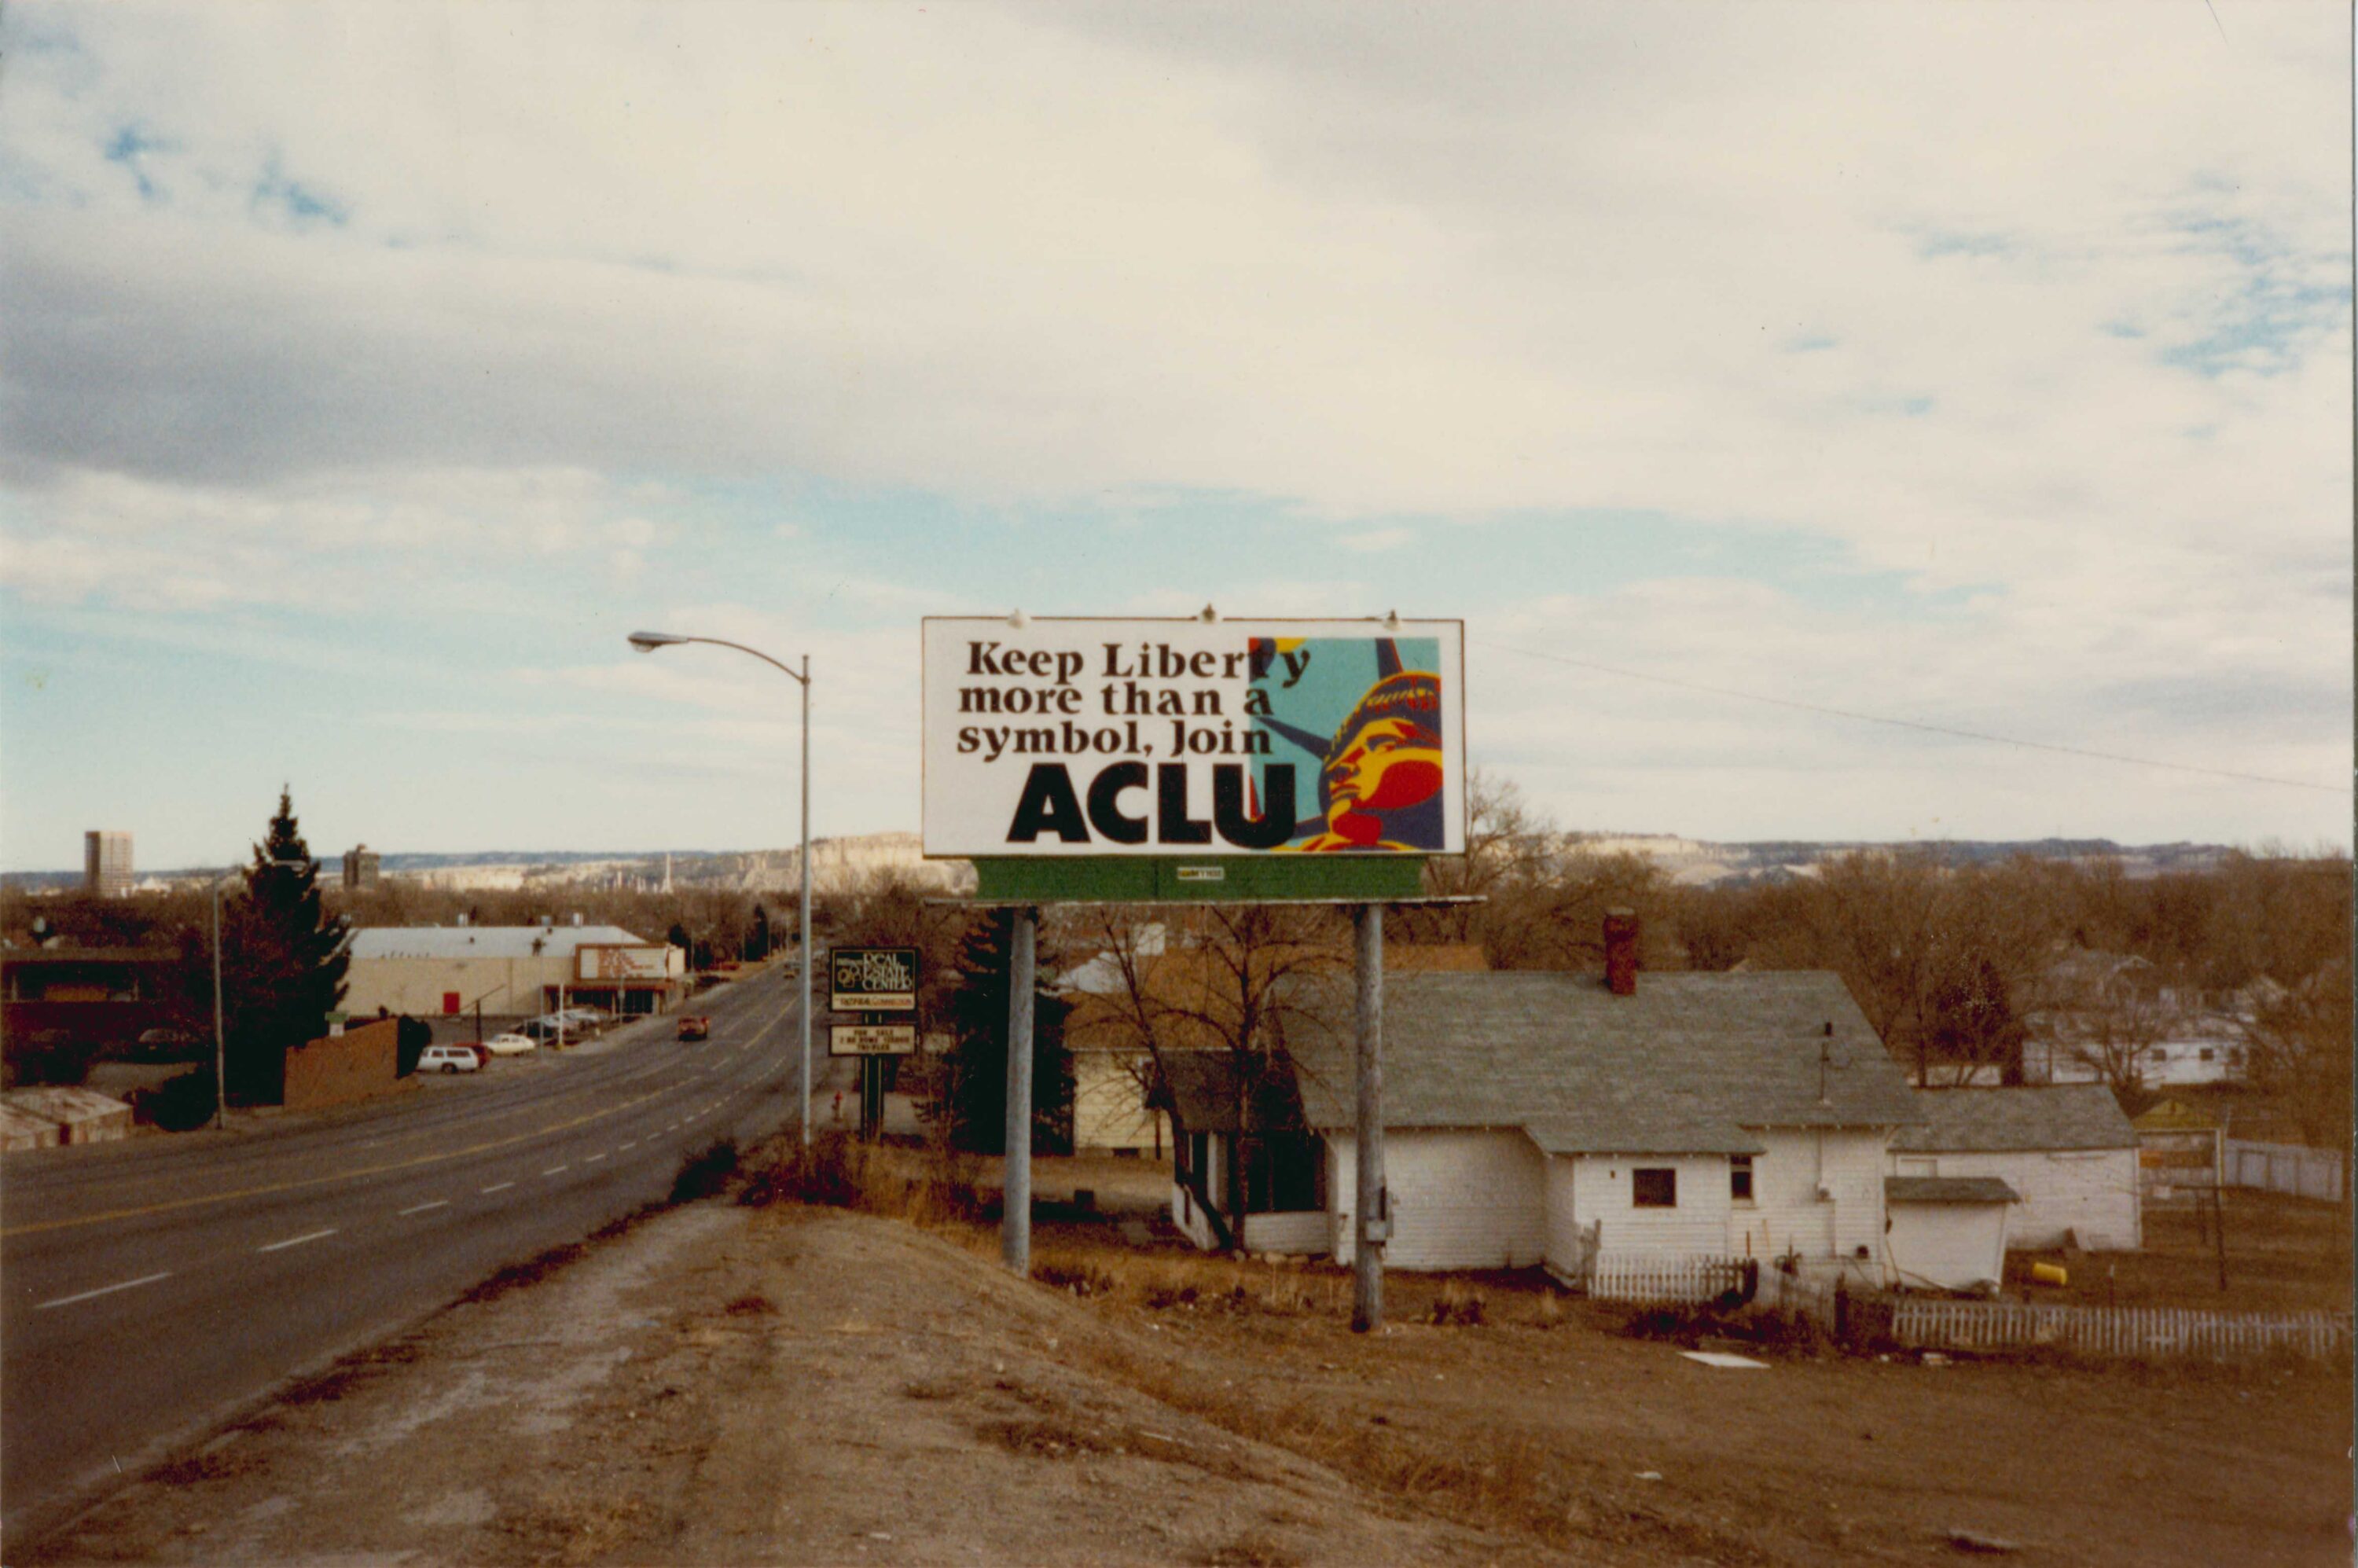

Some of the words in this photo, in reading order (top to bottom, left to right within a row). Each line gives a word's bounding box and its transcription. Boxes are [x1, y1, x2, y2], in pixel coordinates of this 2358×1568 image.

[966, 641, 1085, 685] Keep
[1100, 641, 1310, 689] Liberty
[957, 685, 1083, 714] more
[1100, 681, 1224, 716] than
[1243, 687, 1274, 716] a
[957, 720, 1154, 762] symbol,
[1170, 718, 1274, 757] Join
[1005, 760, 1296, 850] ACLU
[861, 979, 913, 990] CENTER
[863, 964, 909, 980] ESTATE
